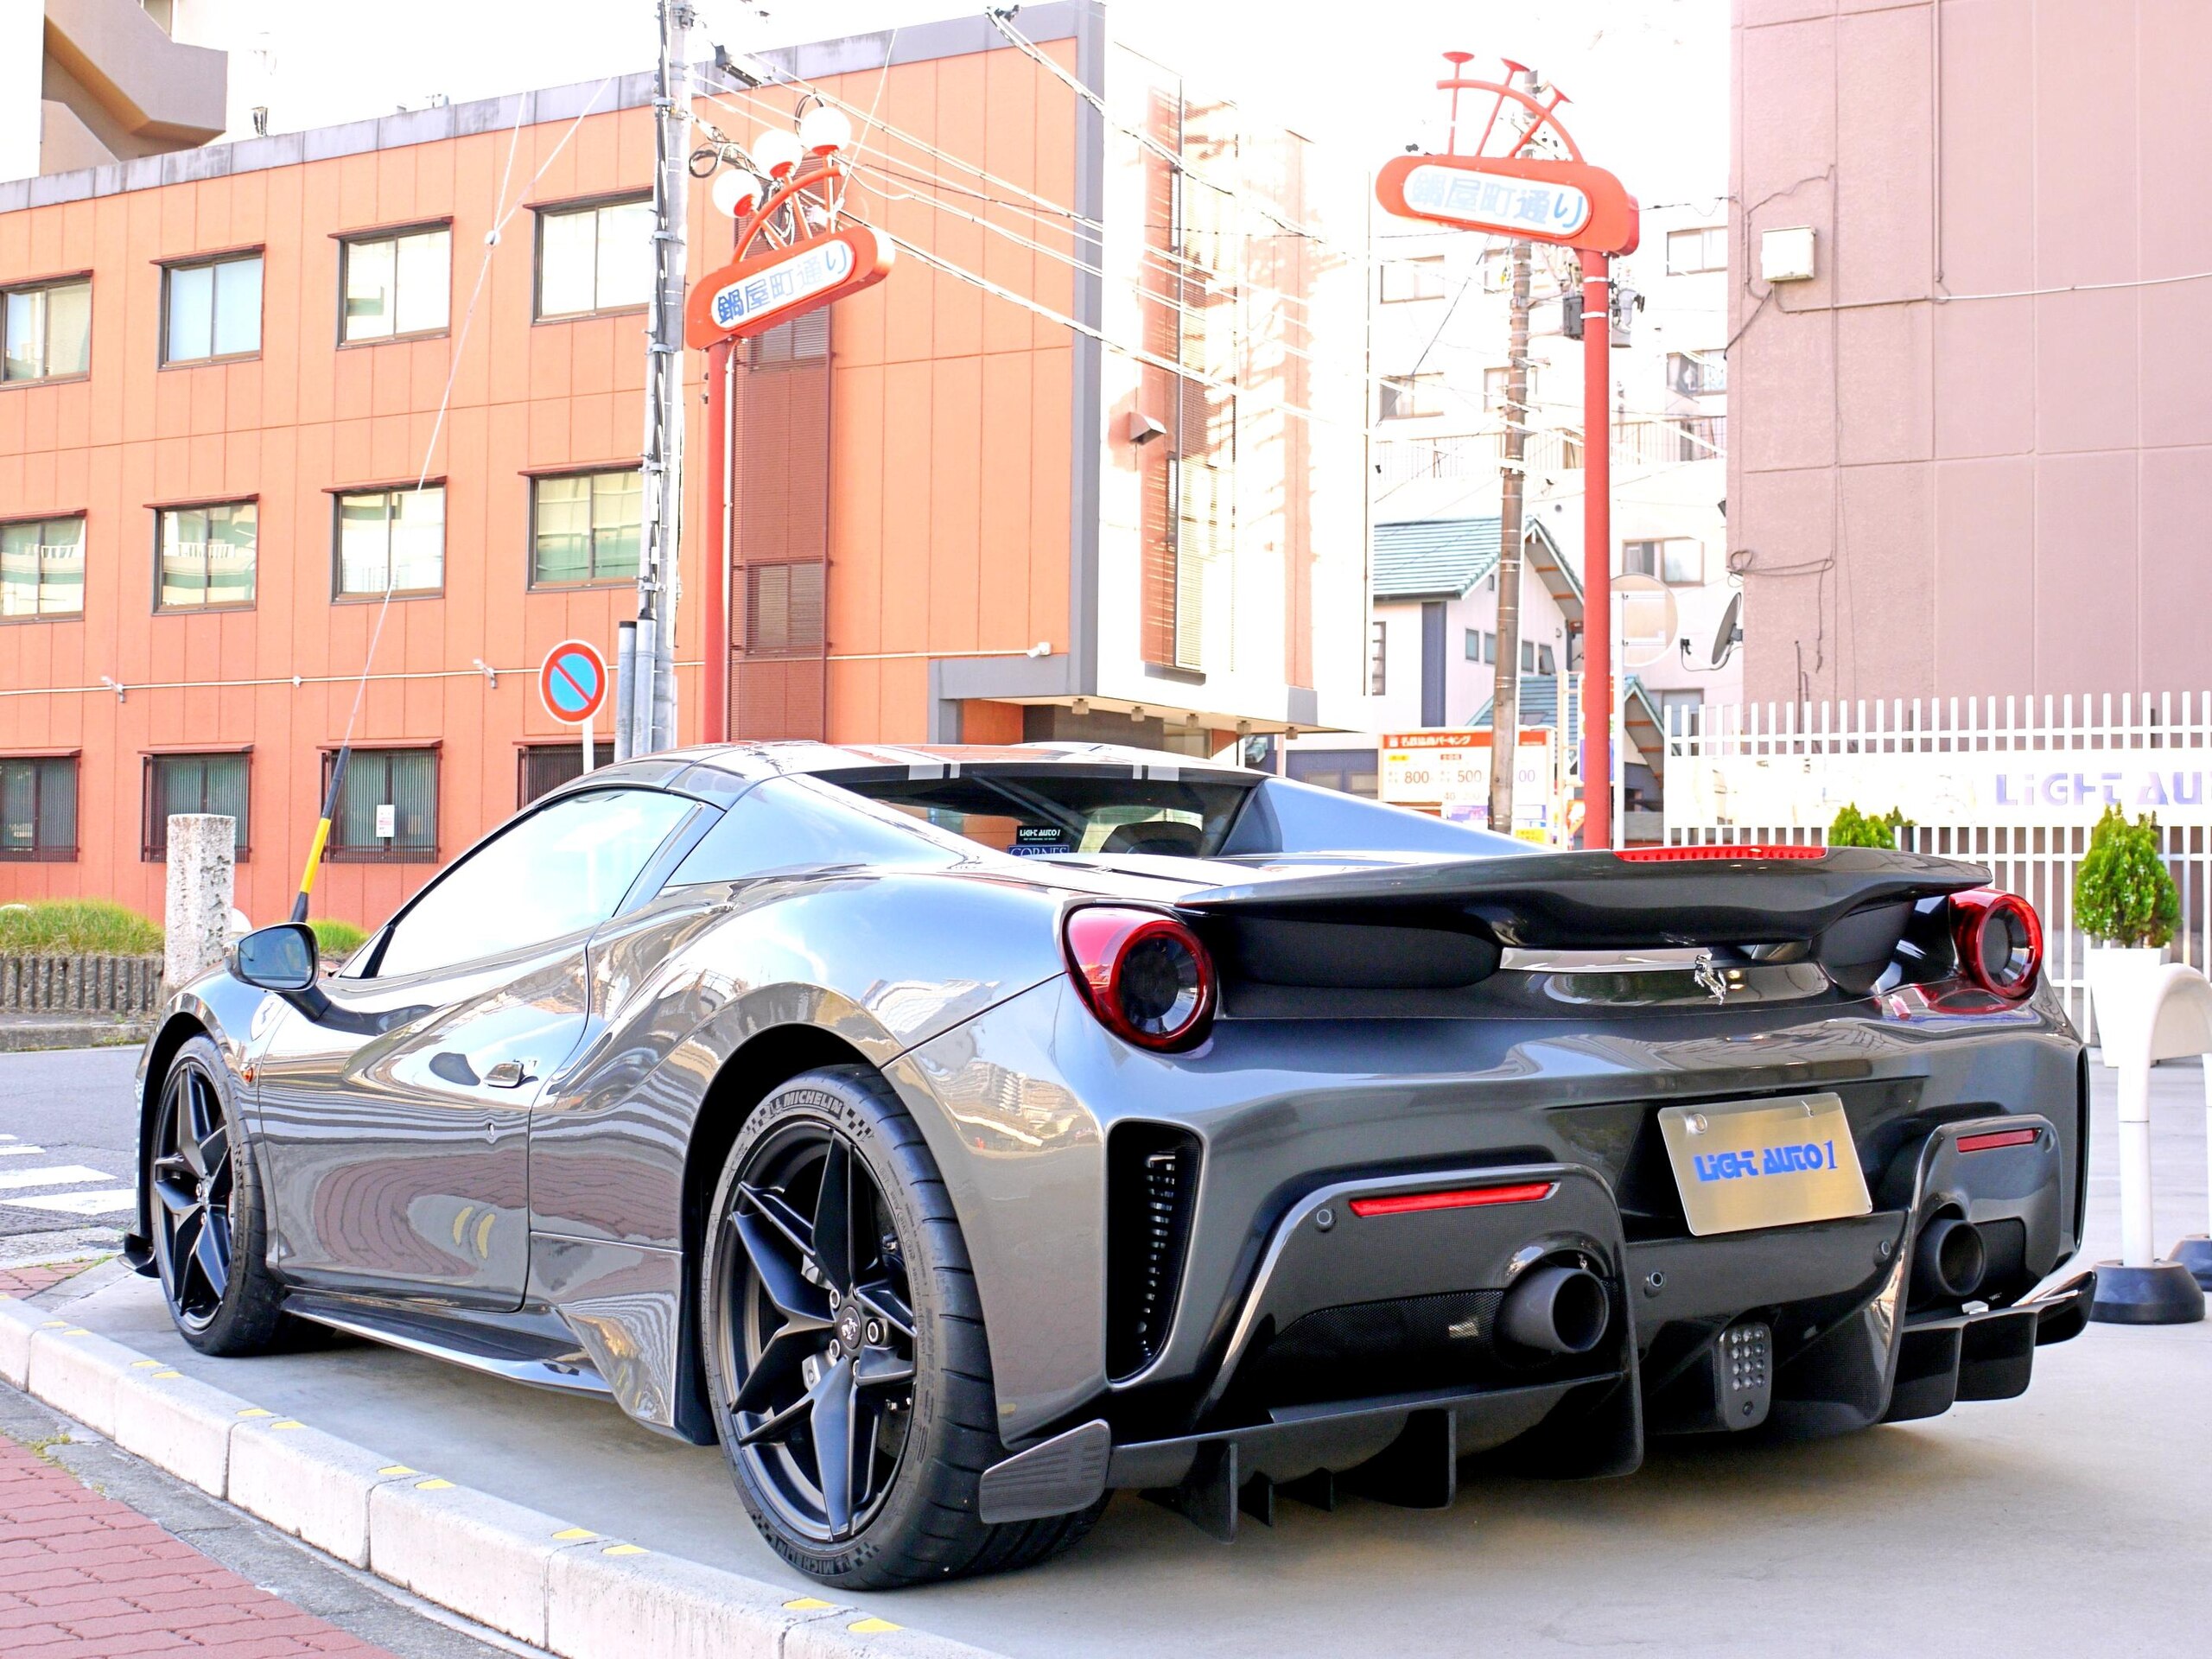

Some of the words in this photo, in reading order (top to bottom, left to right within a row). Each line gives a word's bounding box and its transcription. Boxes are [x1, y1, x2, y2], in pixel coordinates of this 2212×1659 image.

[1410, 172, 1584, 228] 鍋屋町通り
[717, 244, 848, 324] 鍋屋町通り
[1404, 771, 1430, 784] 800
[1458, 769, 1483, 783] 500
[783, 1090, 844, 1115] MICHELIN
